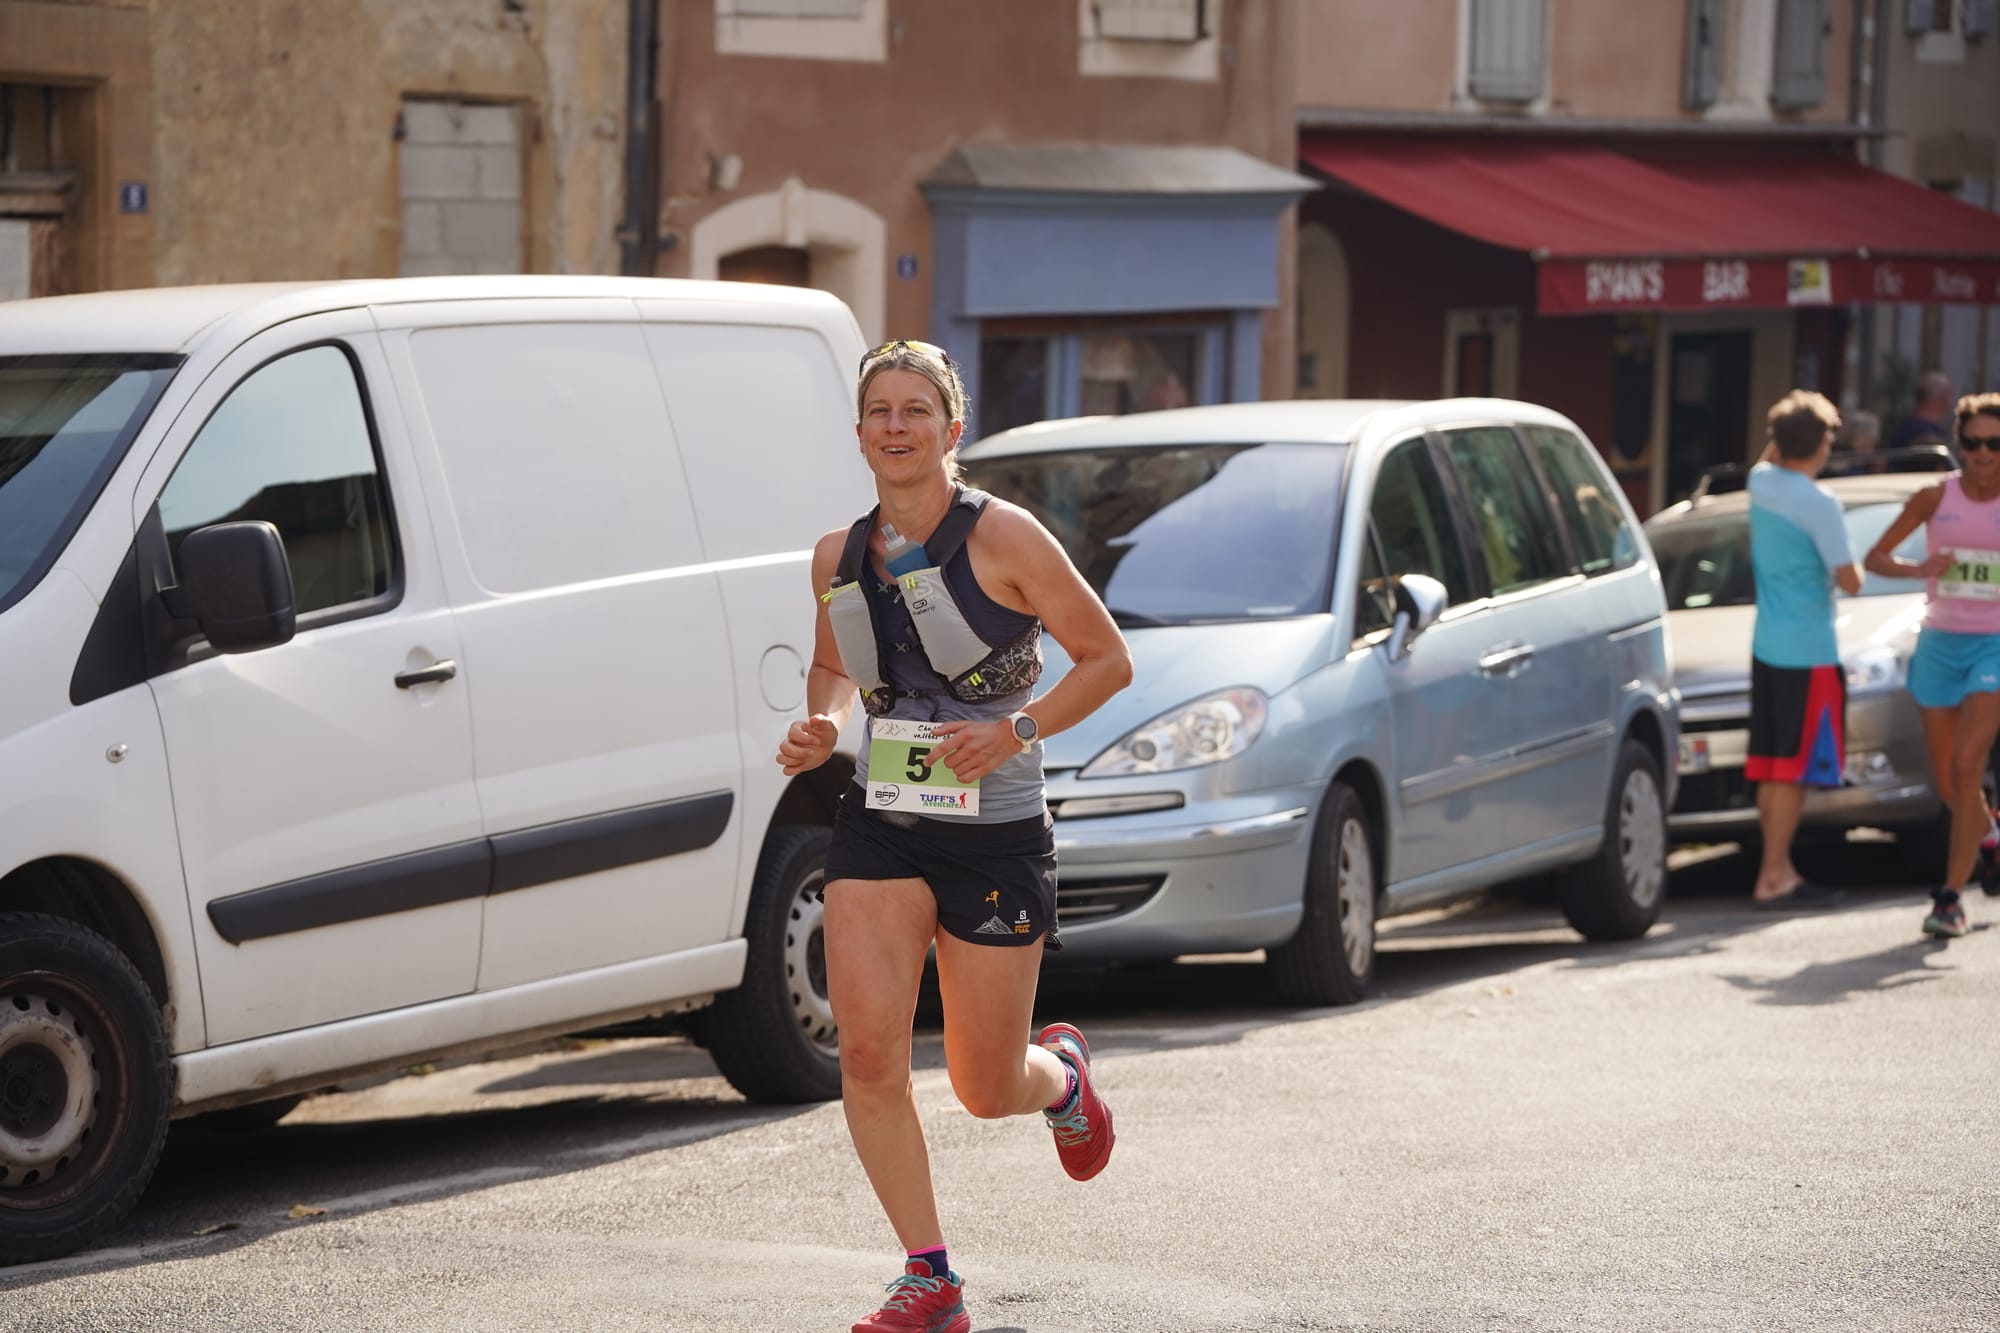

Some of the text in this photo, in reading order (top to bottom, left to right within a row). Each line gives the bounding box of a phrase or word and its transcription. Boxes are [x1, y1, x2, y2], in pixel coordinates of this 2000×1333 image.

[1702, 260, 1750, 301] BAR
[1957, 563, 1989, 583] 18
[906, 746, 932, 782] 5
[920, 793, 956, 803] TUFF'S
[922, 799, 960, 809] Aventure
